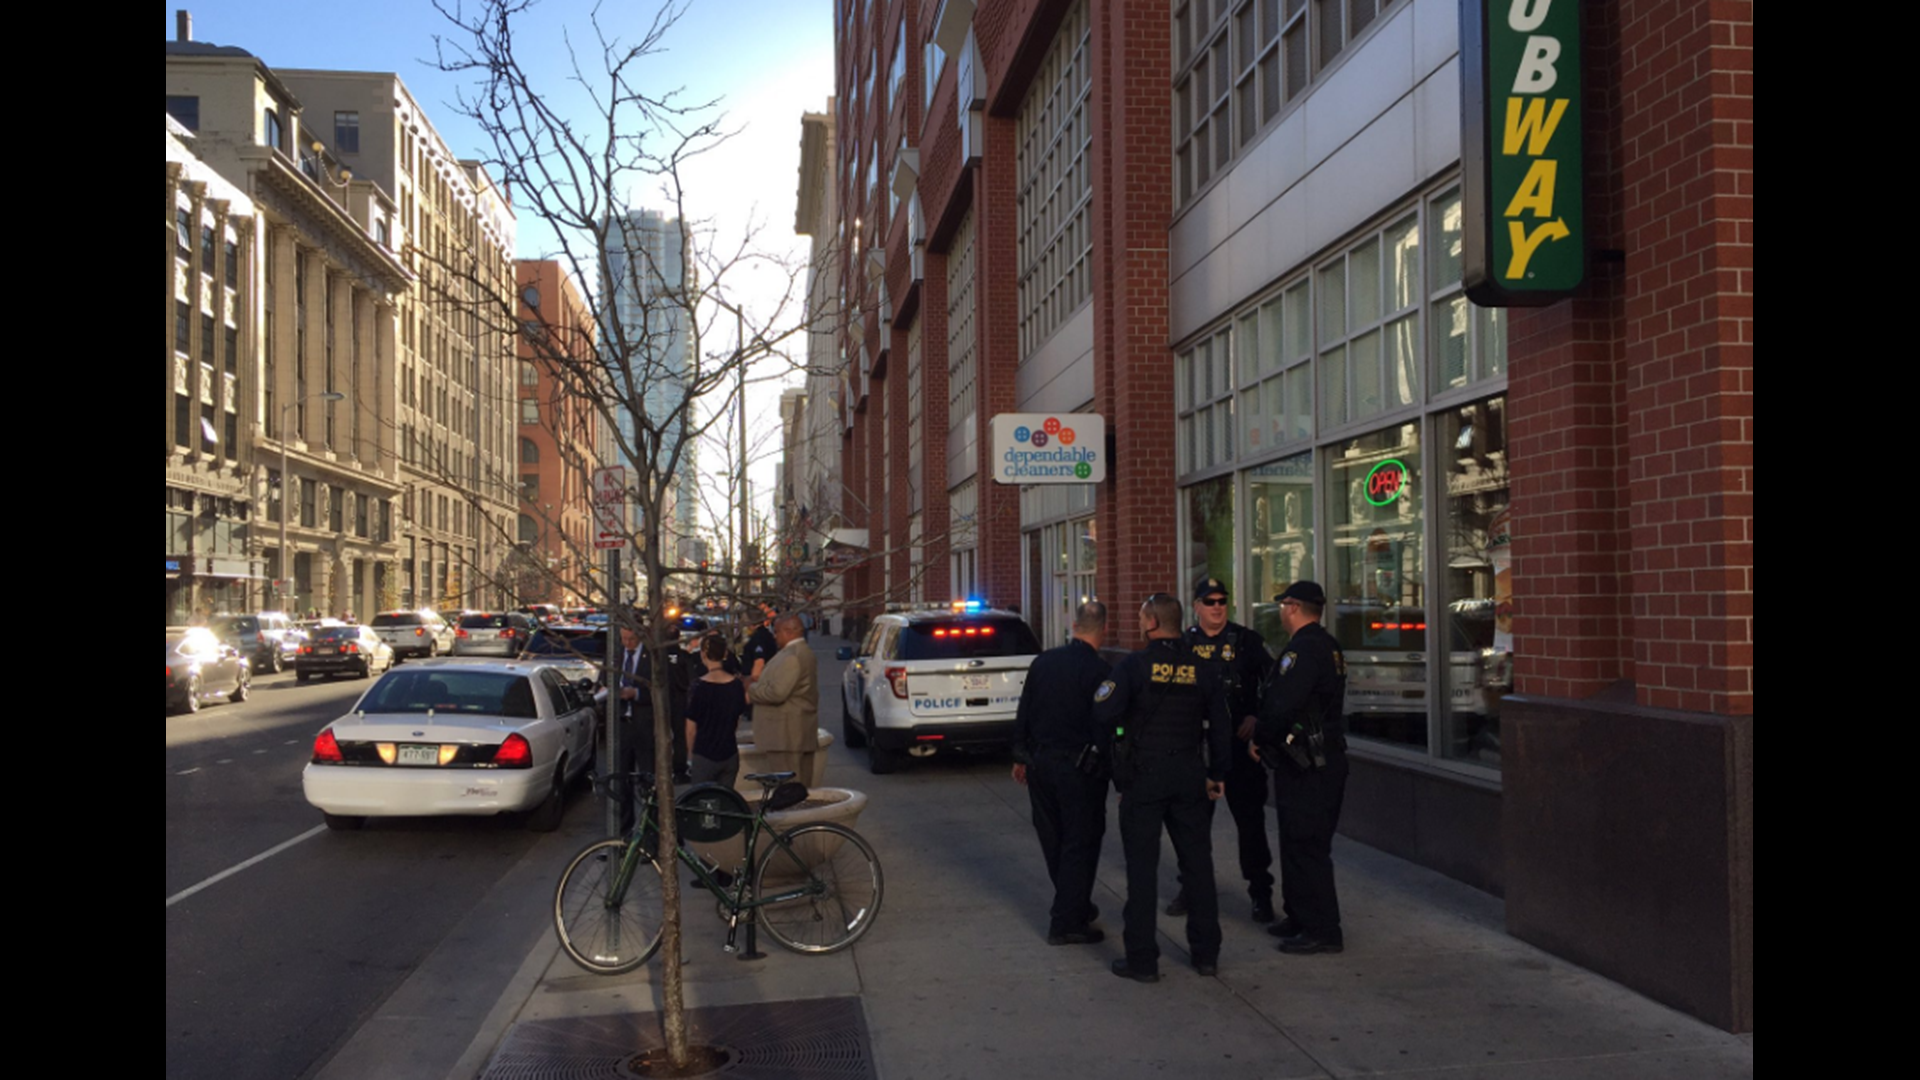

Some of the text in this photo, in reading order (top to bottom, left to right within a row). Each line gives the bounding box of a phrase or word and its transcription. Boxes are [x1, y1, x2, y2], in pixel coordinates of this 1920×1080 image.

[1004, 446, 1096, 464] dependable
[1004, 462, 1074, 477] cleaners
[1370, 470, 1402, 495] OPEN
[1151, 663, 1196, 677] POLICE
[915, 697, 961, 709] POLICE
